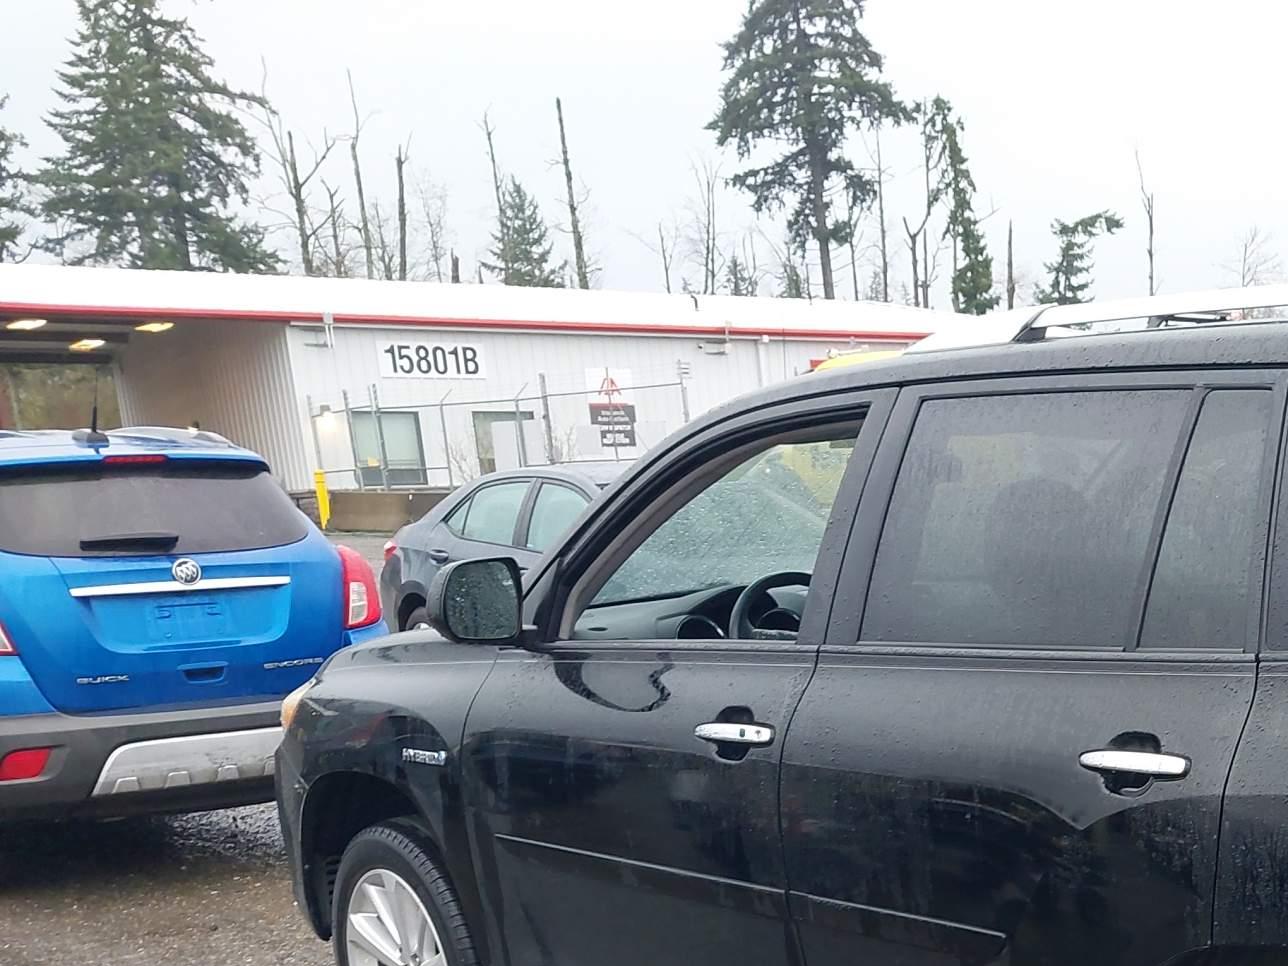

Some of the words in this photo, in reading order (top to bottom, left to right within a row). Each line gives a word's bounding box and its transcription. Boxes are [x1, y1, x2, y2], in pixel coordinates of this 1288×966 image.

[383, 344, 480, 375] 15801B
[263, 657, 324, 670] ENCORE
[76, 674, 130, 685] BUICK
